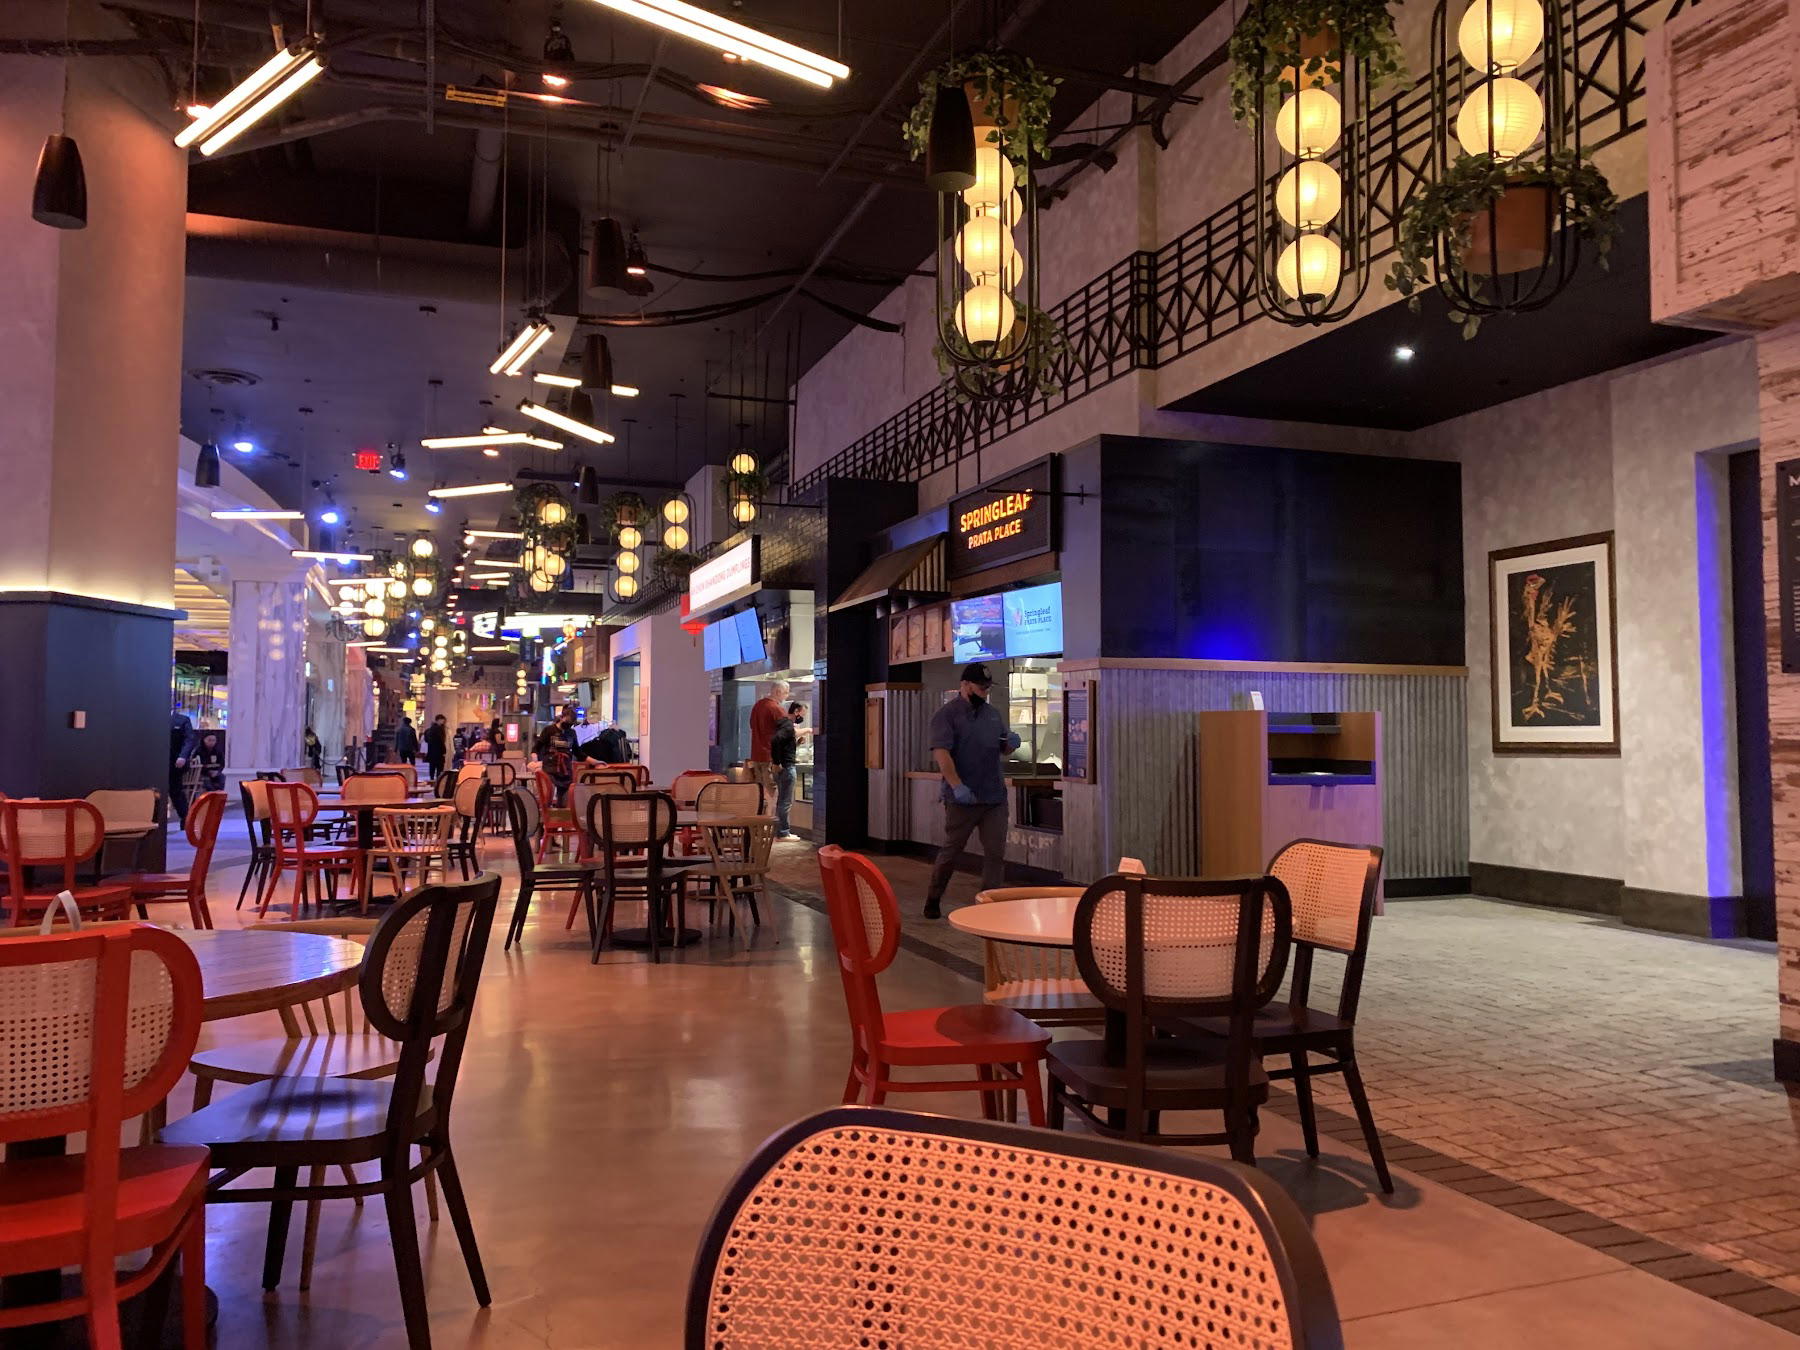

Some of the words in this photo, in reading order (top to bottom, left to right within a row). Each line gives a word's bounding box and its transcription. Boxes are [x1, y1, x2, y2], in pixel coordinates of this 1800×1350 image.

[359, 454, 378, 467] EXIT
[960, 488, 1032, 532] SPRINGLEAF
[968, 529, 993, 549] PRATA
[994, 518, 1022, 540] PLACE
